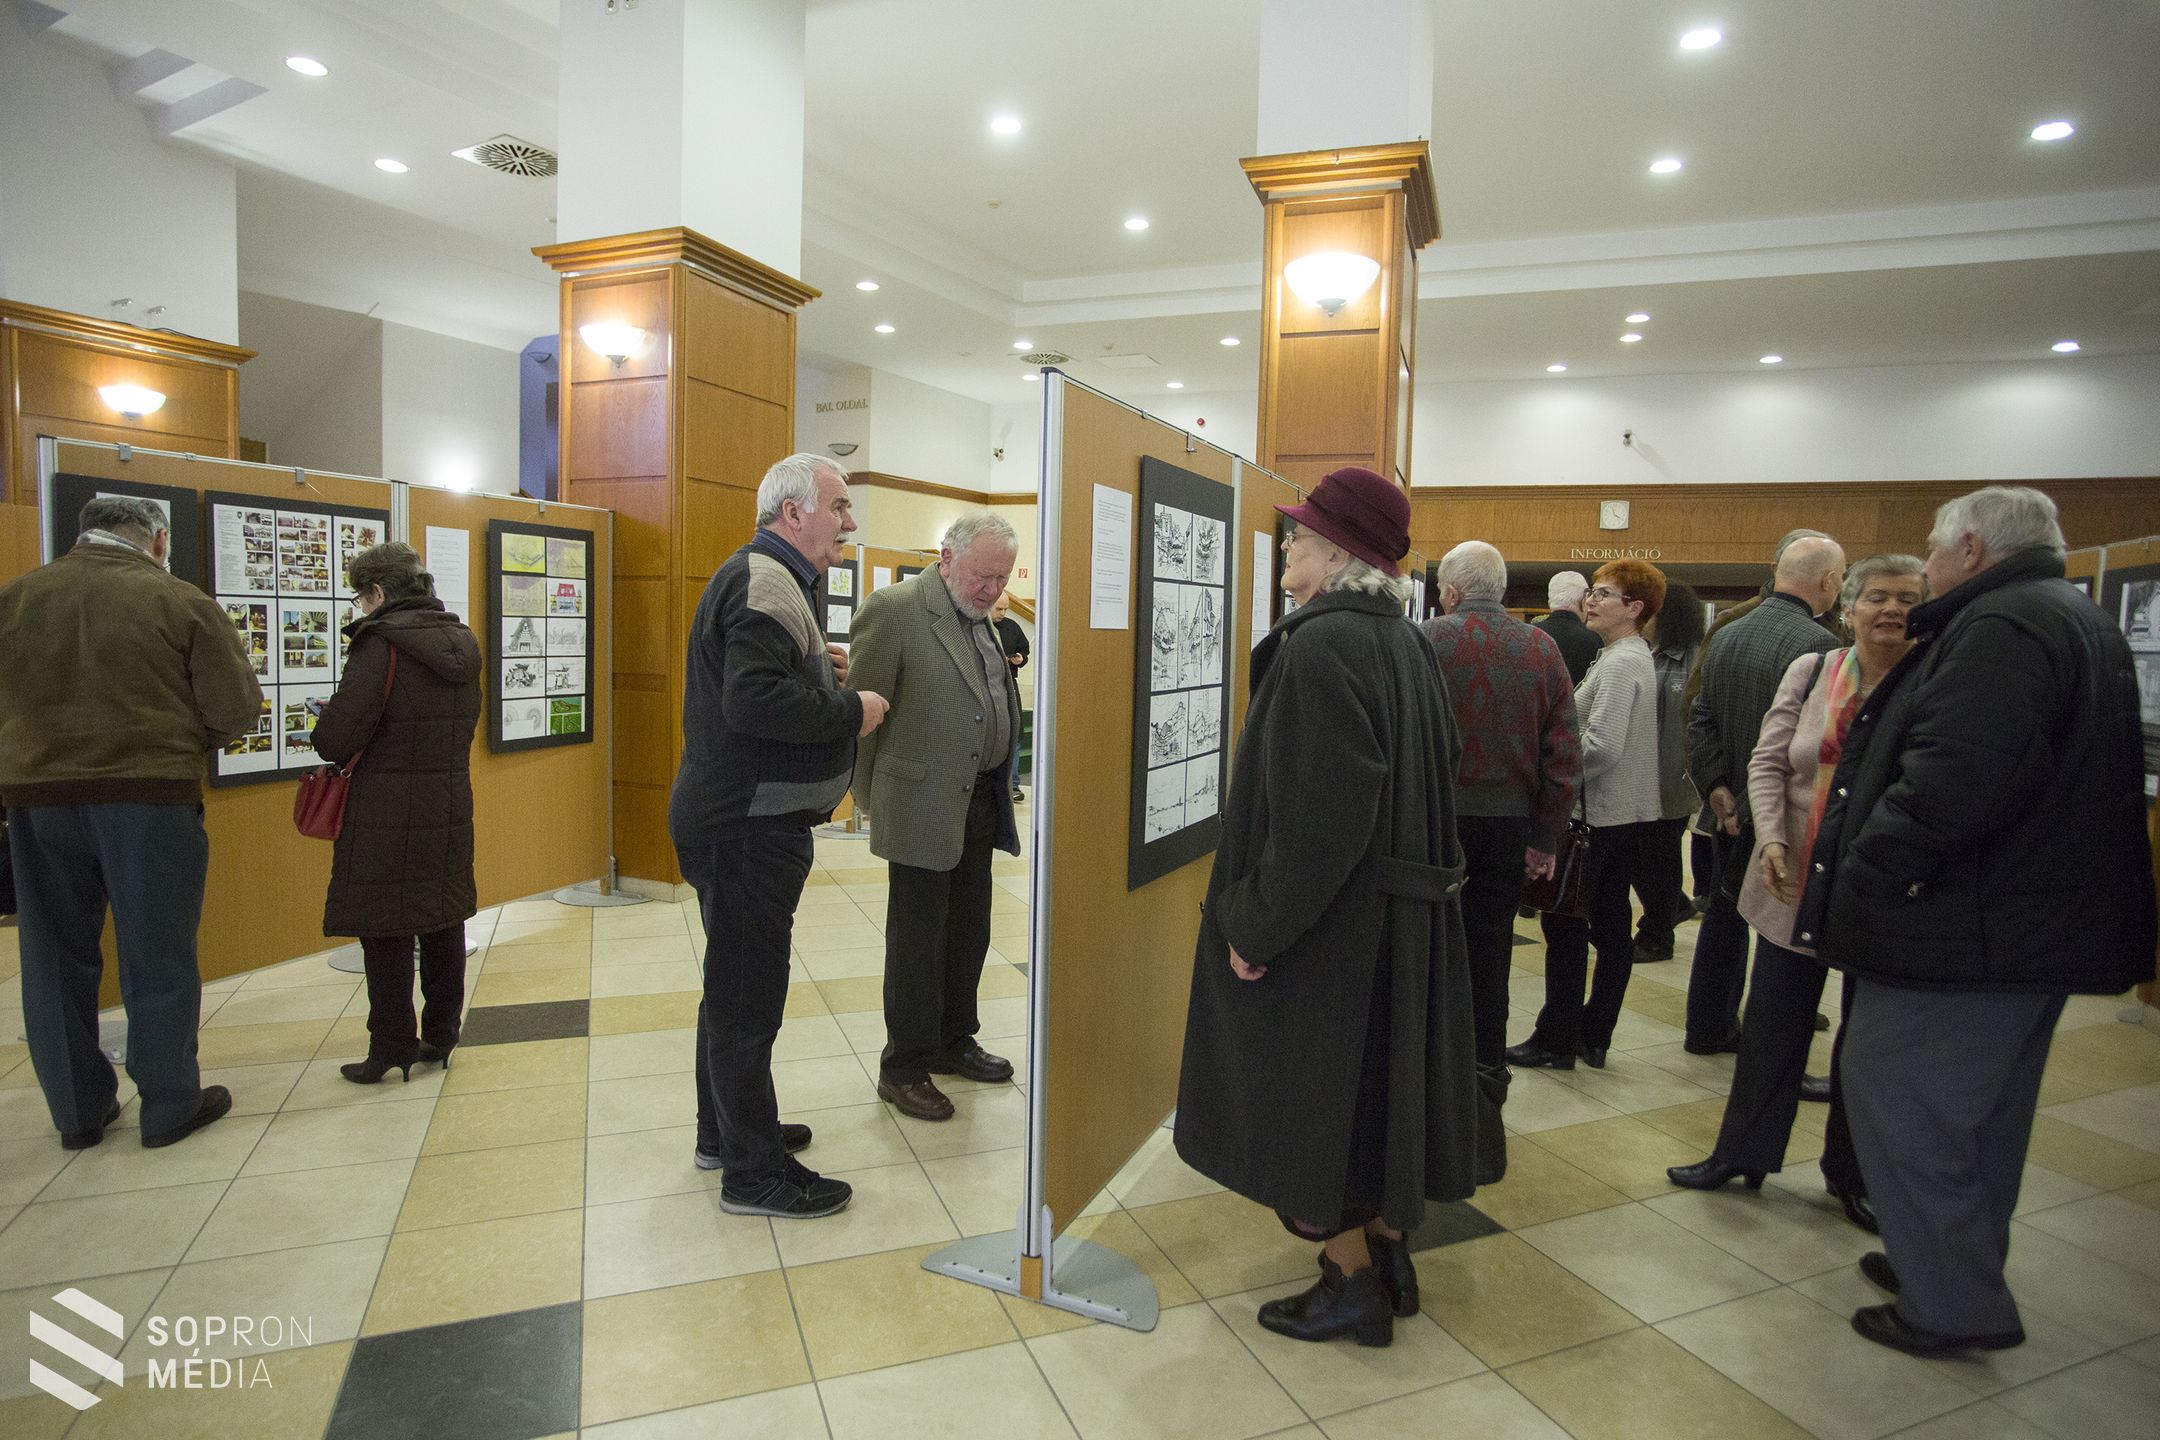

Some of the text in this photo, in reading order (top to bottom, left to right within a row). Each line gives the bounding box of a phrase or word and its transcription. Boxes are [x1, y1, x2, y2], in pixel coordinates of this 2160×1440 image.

[816, 399, 868, 413] BAL OLDAL
[1571, 546, 1661, 560] INFORMÁCIÓ
